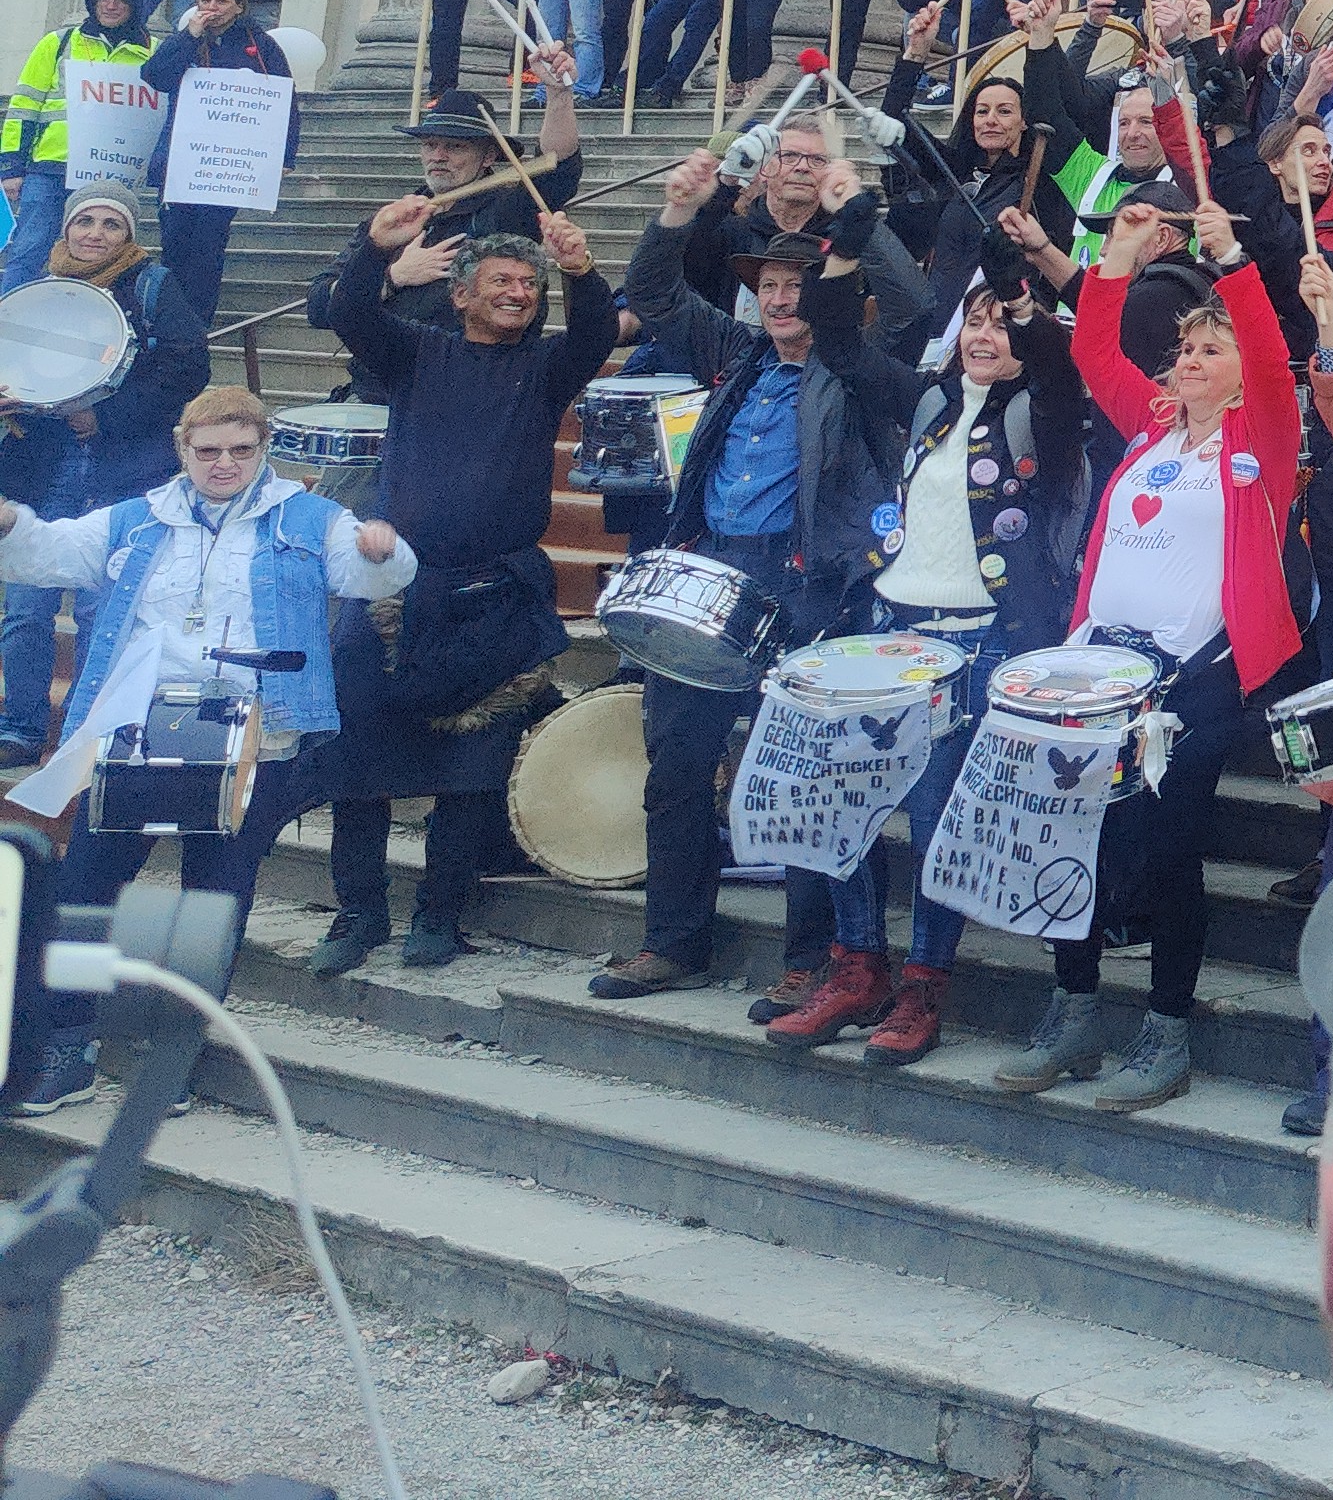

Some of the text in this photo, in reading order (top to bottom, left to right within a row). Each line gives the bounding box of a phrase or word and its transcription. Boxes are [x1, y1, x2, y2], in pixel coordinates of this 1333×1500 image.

[81, 79, 160, 111] NEIN
[193, 80, 281, 99] Wir brauchen
[200, 95, 272, 112] nicht mehr
[207, 110, 261, 126] Waffen.
[114, 137, 126, 145] zu
[90, 147, 146, 170] Rüstung
[190, 142, 268, 159] Wir brauchen
[200, 155, 254, 171] MEDIEN,
[75, 170, 101, 181] und
[194, 169, 256, 183] die ehrlich
[188, 181, 245, 195] berichten
[1105, 523, 1176, 550] Familie
[809, 741, 834, 762] DIE
[994, 760, 1019, 784] DIE
[747, 774, 778, 798] ONE
[744, 794, 778, 811] ONE
